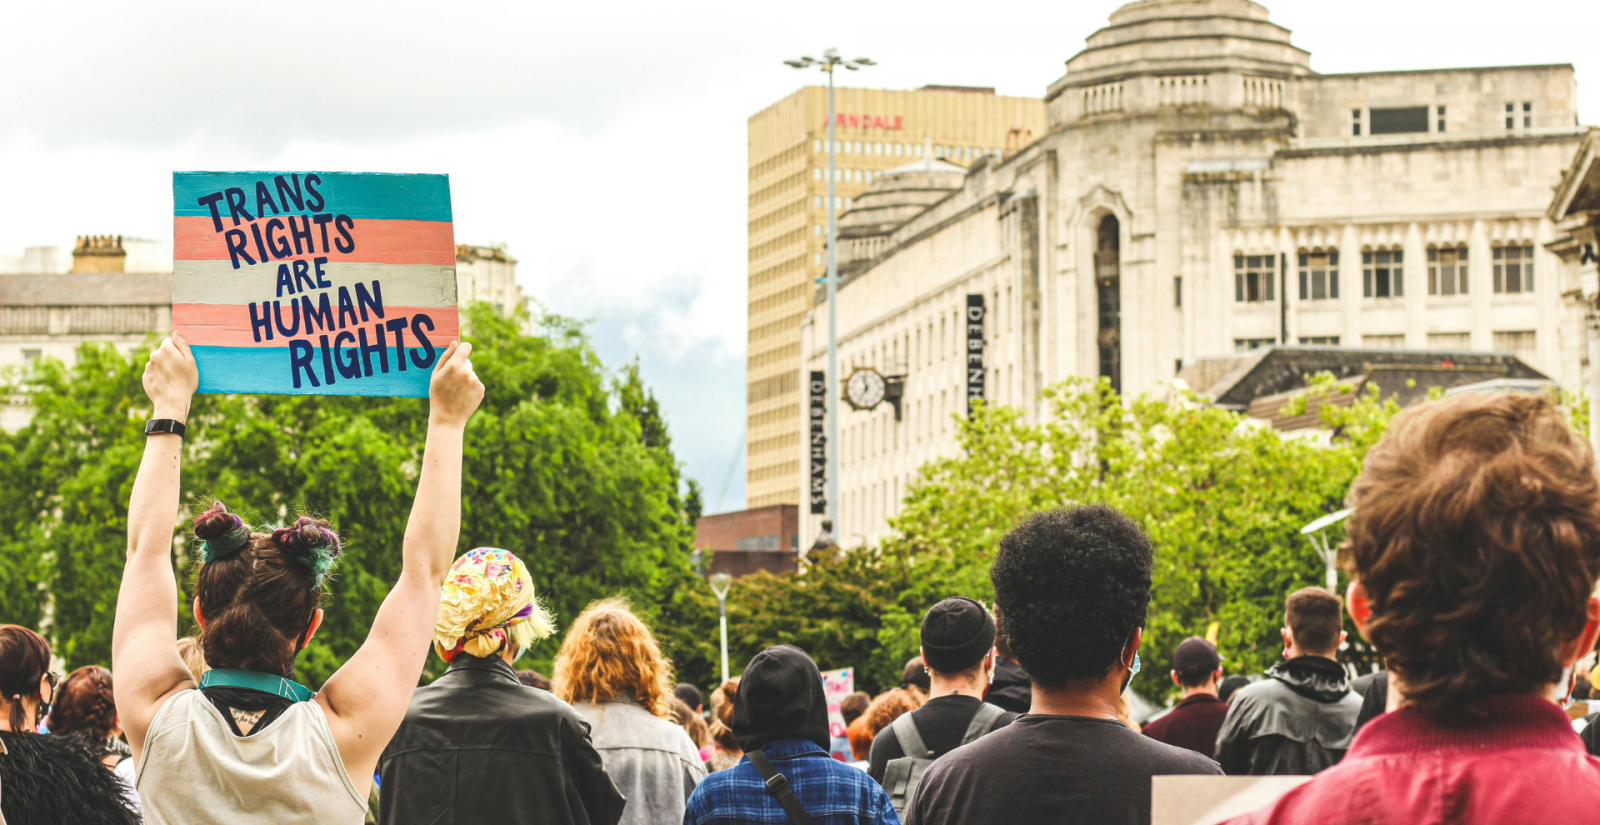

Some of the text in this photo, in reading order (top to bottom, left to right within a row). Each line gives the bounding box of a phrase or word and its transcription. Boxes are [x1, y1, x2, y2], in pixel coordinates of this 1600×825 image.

[197, 173, 325, 233] TRANS
[224, 213, 355, 269] RIGHTS
[276, 257, 332, 297] ARE
[249, 280, 385, 342] HUMAN
[288, 313, 436, 389] RIGHTS
[967, 306, 983, 402] DEBENH
[811, 380, 825, 505] DEBENHAMS
